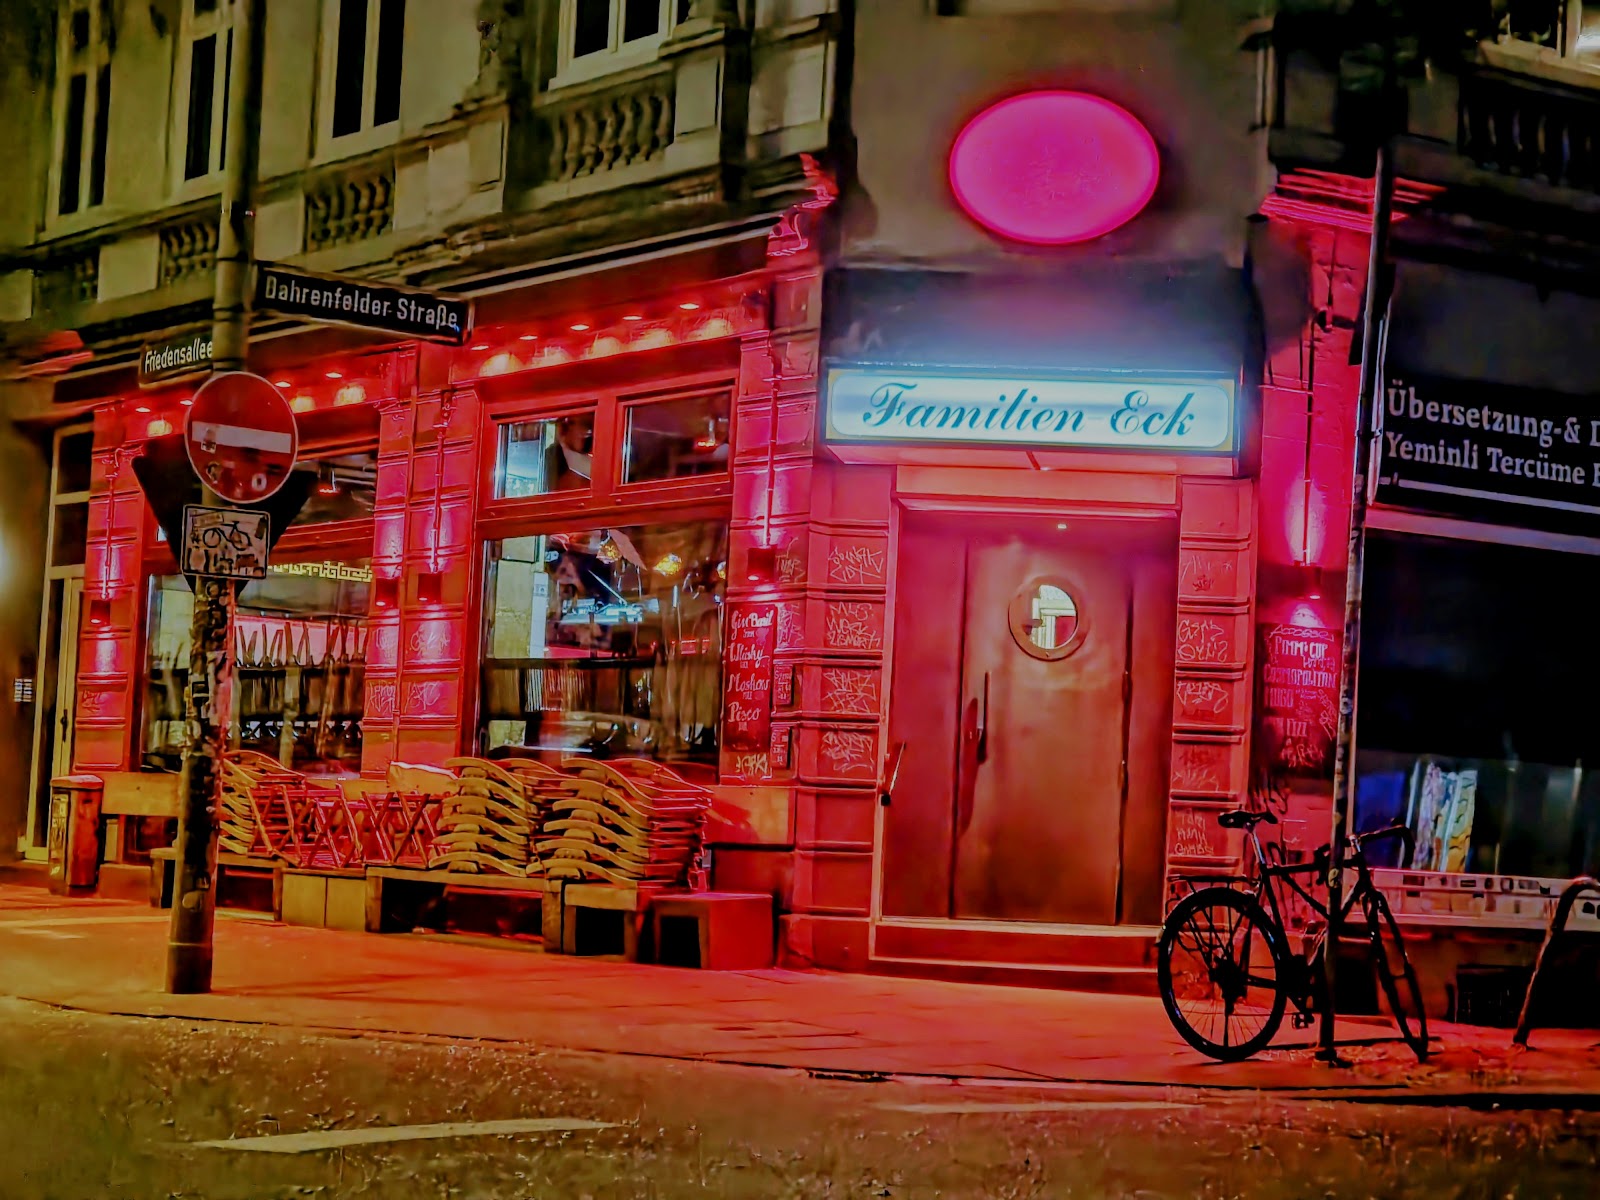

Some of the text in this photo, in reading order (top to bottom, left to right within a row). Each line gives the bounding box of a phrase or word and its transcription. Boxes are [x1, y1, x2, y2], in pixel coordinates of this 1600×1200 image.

[396, 298, 460, 330] Straße
[144, 337, 213, 374] Friedensallee
[862, 382, 1196, 436] Familien Eck
[1385, 430, 1479, 470] Yeminli
[1486, 446, 1586, 485] Tercüme
[728, 701, 761, 723] Pisco
